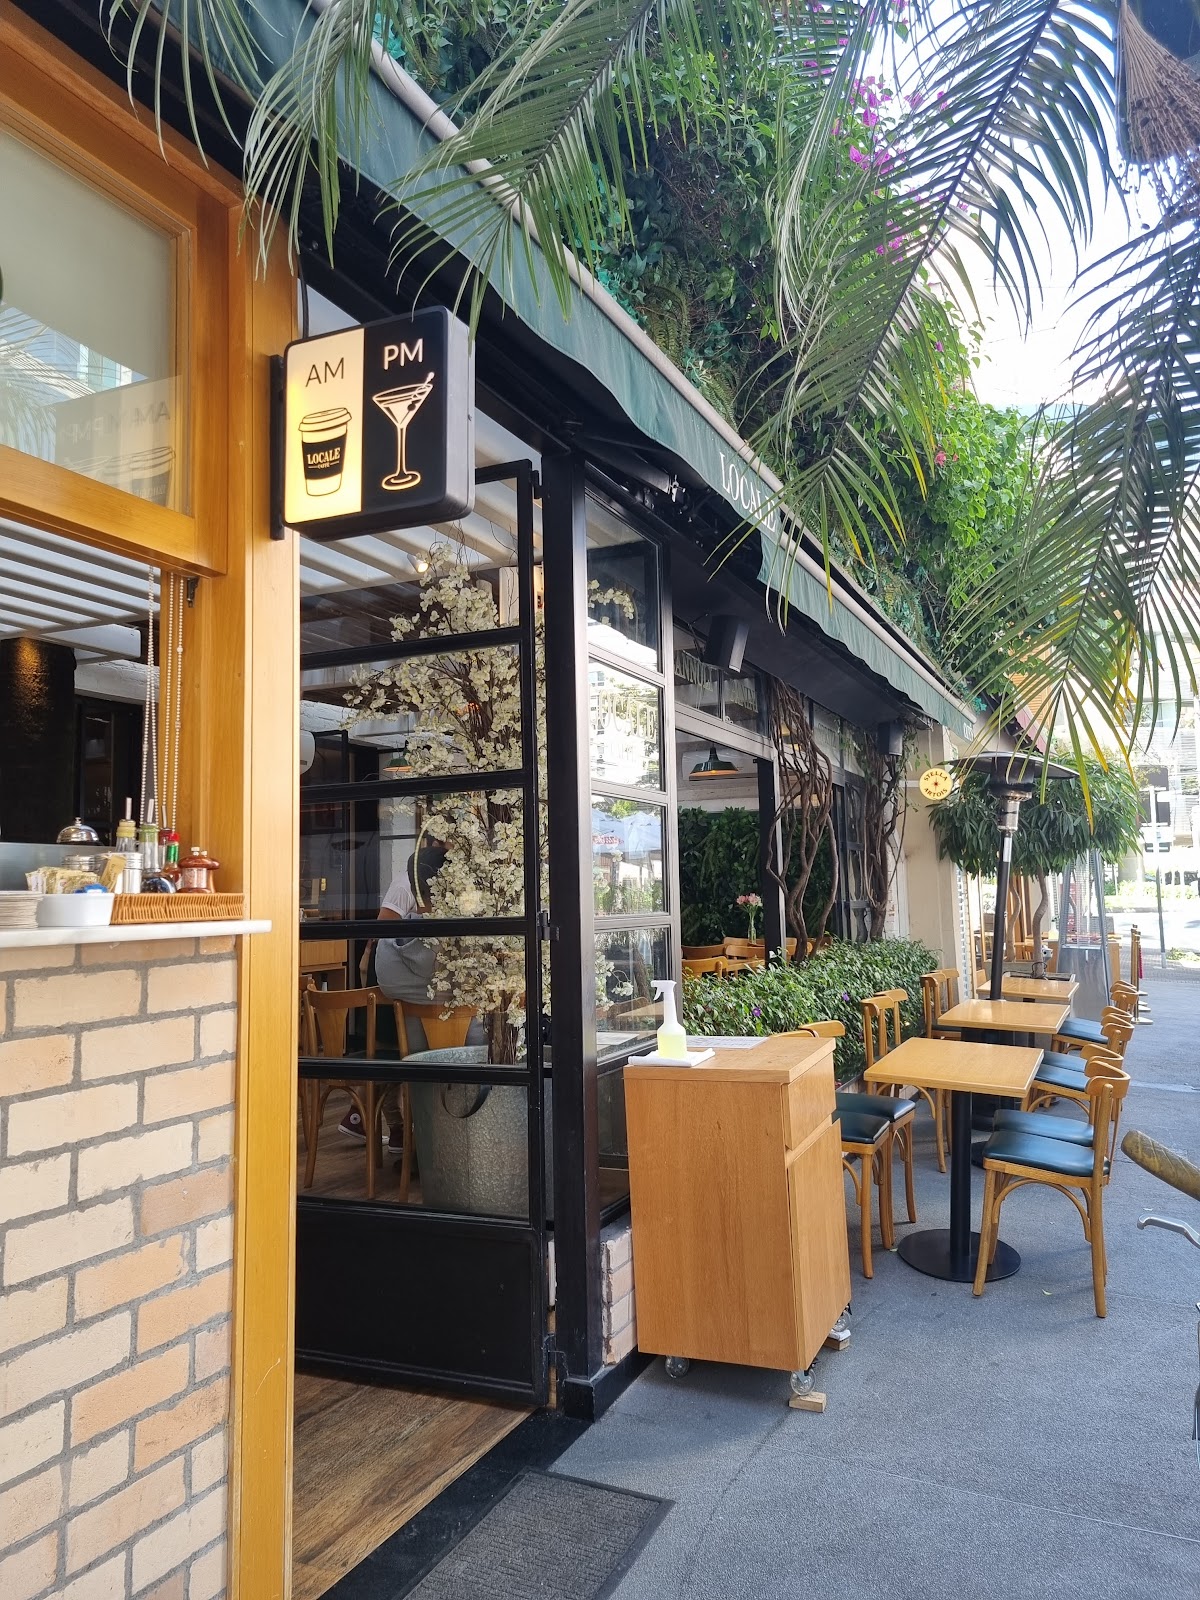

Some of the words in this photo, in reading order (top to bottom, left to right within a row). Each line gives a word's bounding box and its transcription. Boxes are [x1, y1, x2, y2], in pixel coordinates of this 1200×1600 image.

[383, 338, 424, 370] PM
[305, 357, 345, 388] AM
[306, 446, 341, 465] LOCALE
[719, 451, 776, 533] LOCALE
[923, 770, 948, 781] STELLA
[923, 787, 948, 798] ARTOIS
